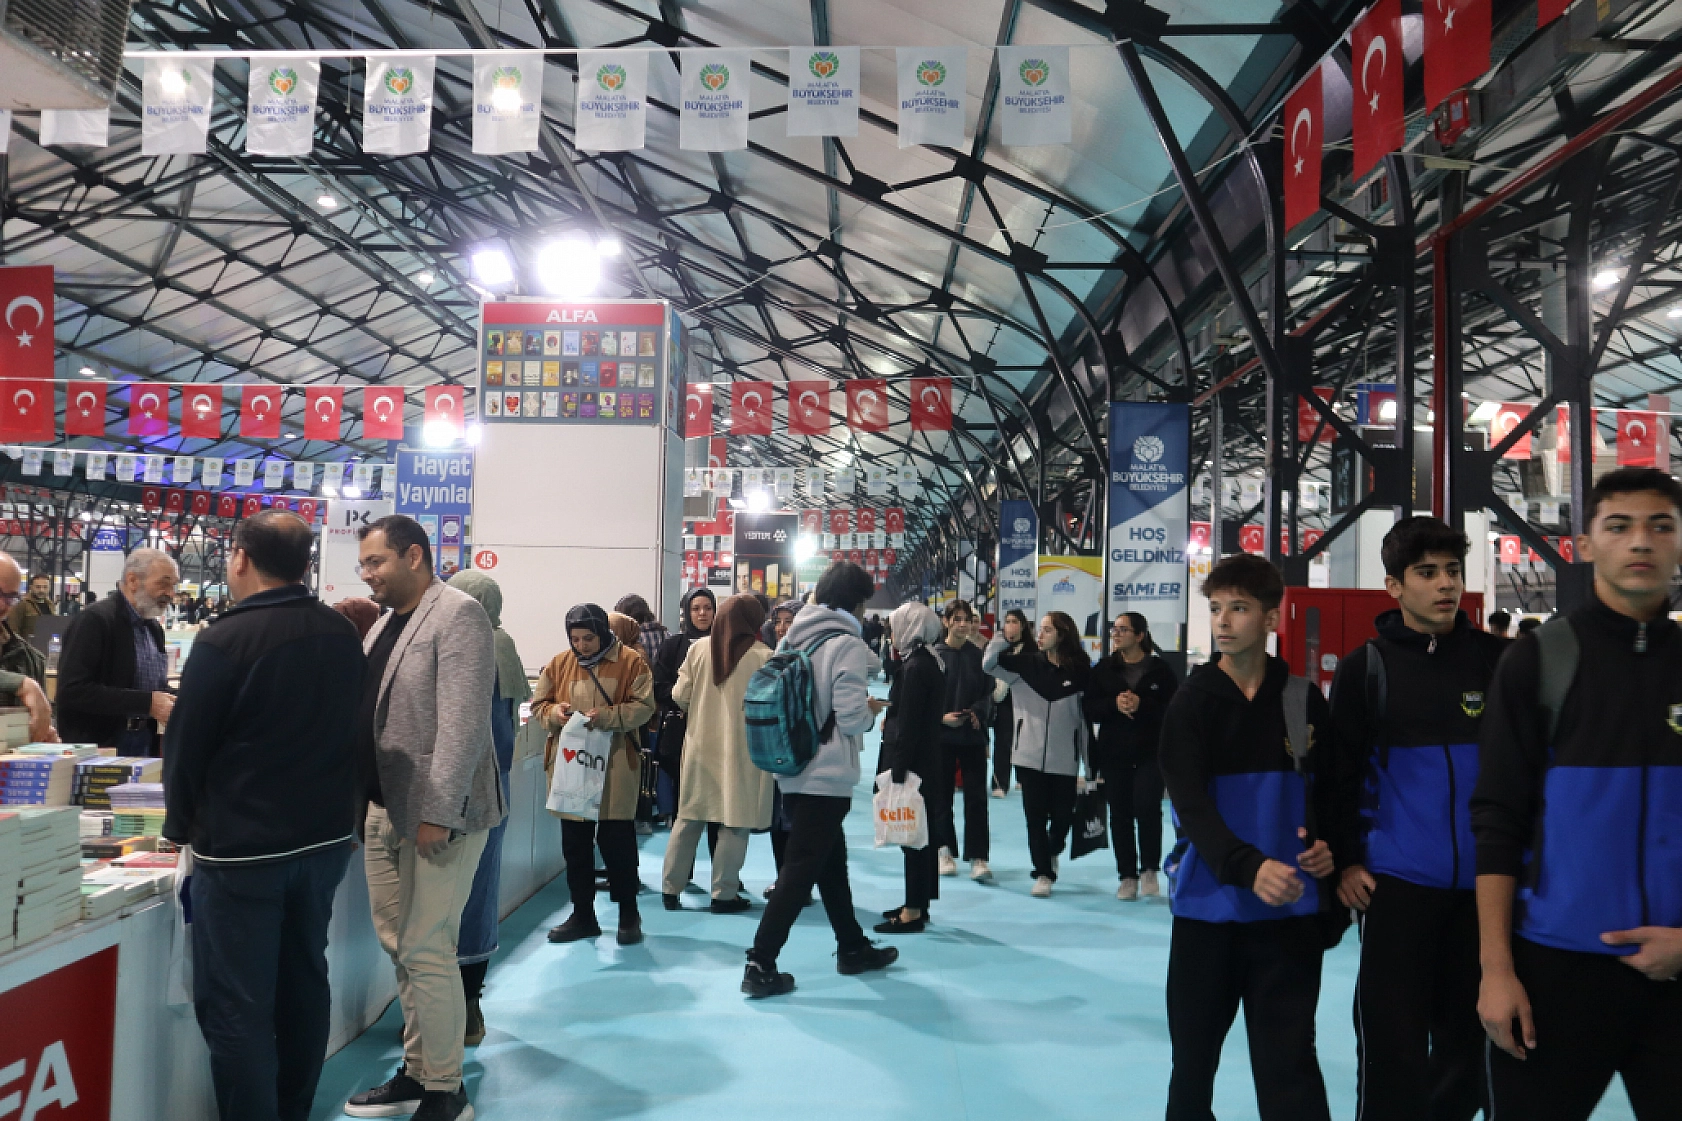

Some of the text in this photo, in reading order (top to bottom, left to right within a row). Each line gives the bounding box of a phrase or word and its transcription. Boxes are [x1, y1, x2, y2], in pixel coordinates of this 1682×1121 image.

[545, 309, 599, 323] ALFA
[413, 455, 471, 482] Hayat
[1129, 463, 1168, 471] MALATYA
[1128, 527, 1167, 544] HOŞ
[480, 552, 493, 568] 45
[1111, 547, 1185, 564] GELDİNİZ
[1158, 582, 1182, 595] ER
